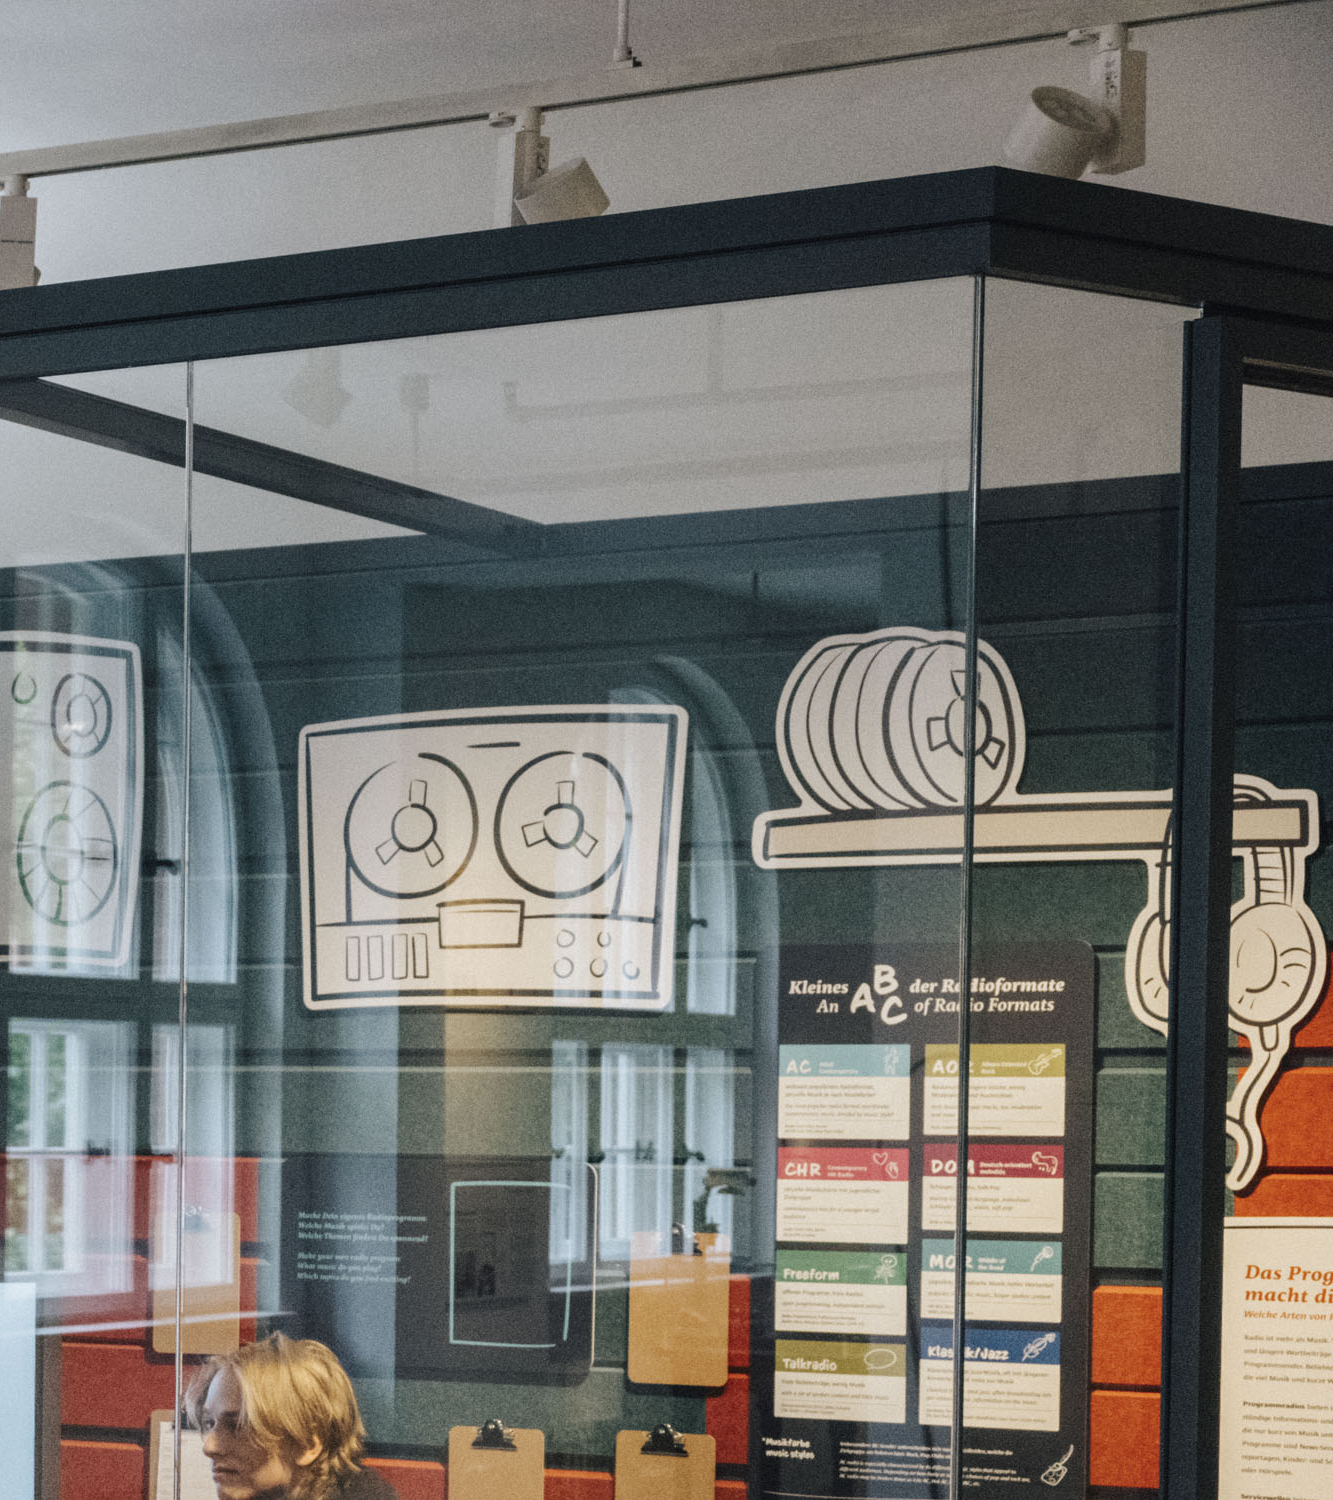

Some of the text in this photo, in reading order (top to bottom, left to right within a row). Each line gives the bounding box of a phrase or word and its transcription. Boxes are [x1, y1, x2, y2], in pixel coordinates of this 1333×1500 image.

[789, 979, 849, 995] Kleines
[909, 978, 938, 993] der
[816, 999, 839, 1013] An
[914, 998, 933, 1016] of
[988, 997, 1055, 1012] Formats
[786, 1058, 812, 1074] AC
[784, 1161, 822, 1177] CHR
[783, 1268, 840, 1281] Freeform
[1245, 1264, 1333, 1287] Das Prog
[1245, 1287, 1309, 1303] macht
[1244, 1310, 1327, 1321] Welche Arten von
[782, 1357, 838, 1371] Talkradio
